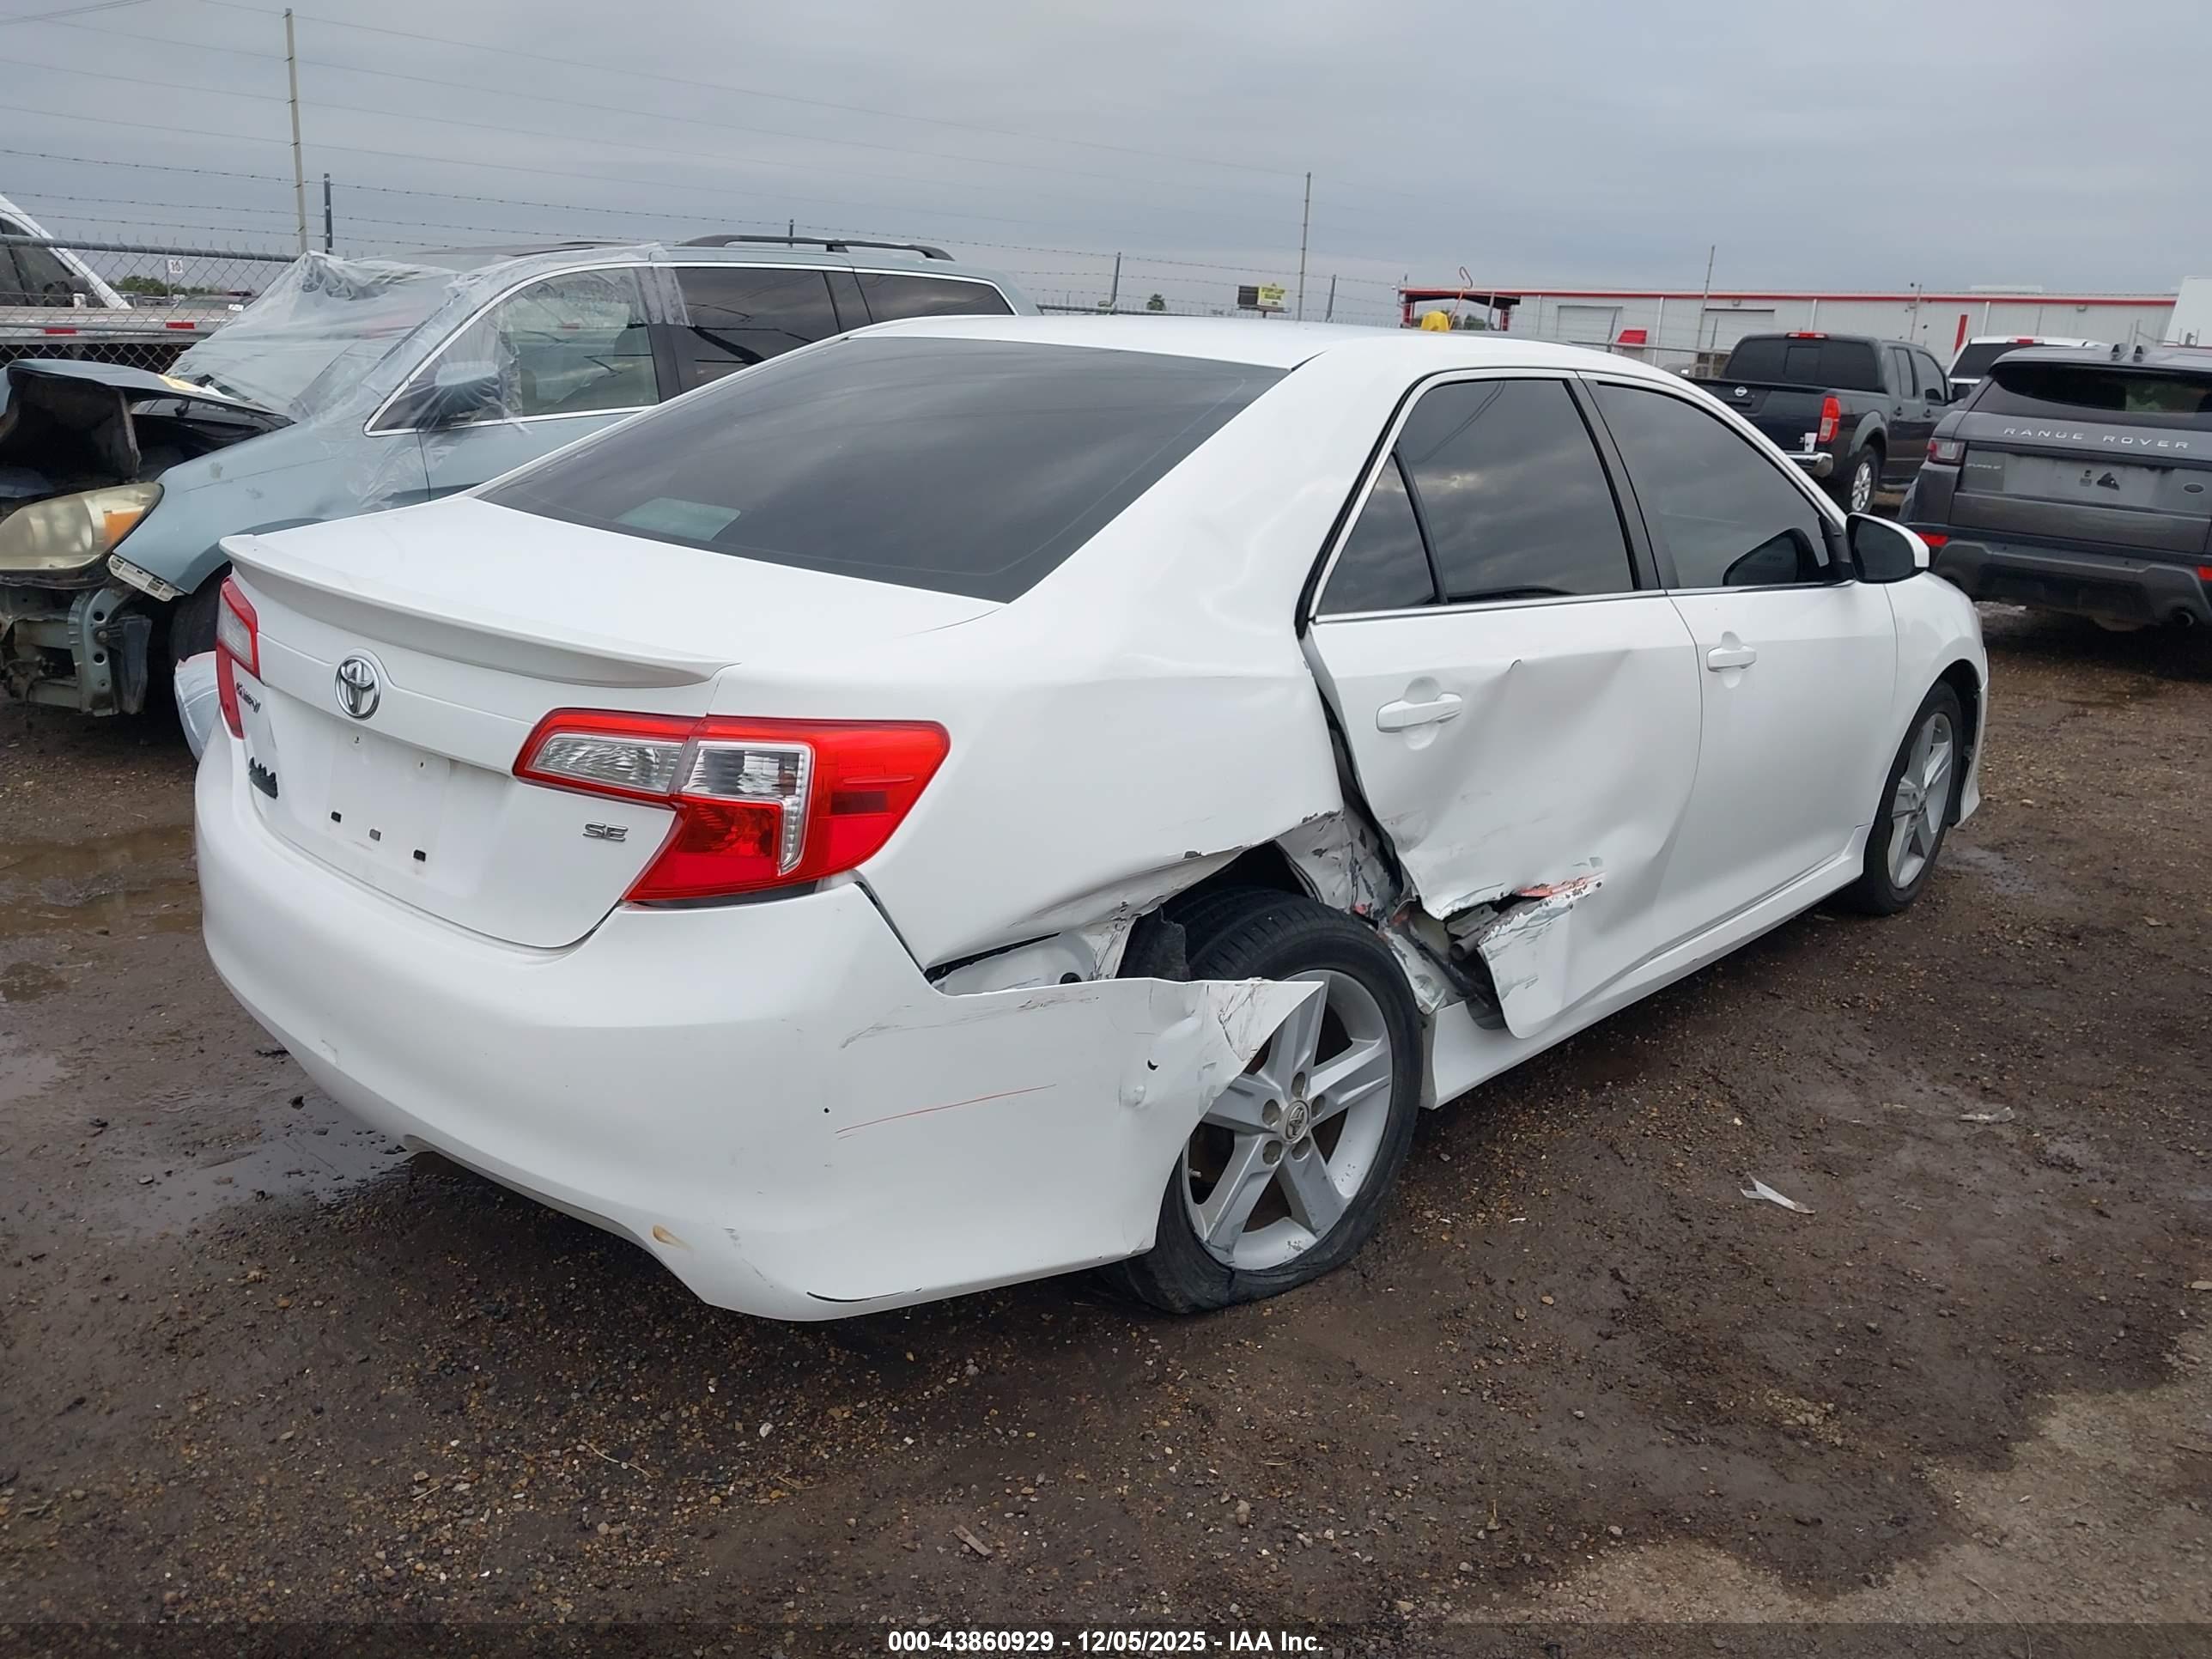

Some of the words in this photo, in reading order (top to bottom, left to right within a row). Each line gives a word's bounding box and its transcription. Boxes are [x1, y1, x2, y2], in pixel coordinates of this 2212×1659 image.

[2003, 428, 2085, 440] RANGE
[2103, 435, 2189, 449] ROVER
[582, 823, 629, 842] SE
